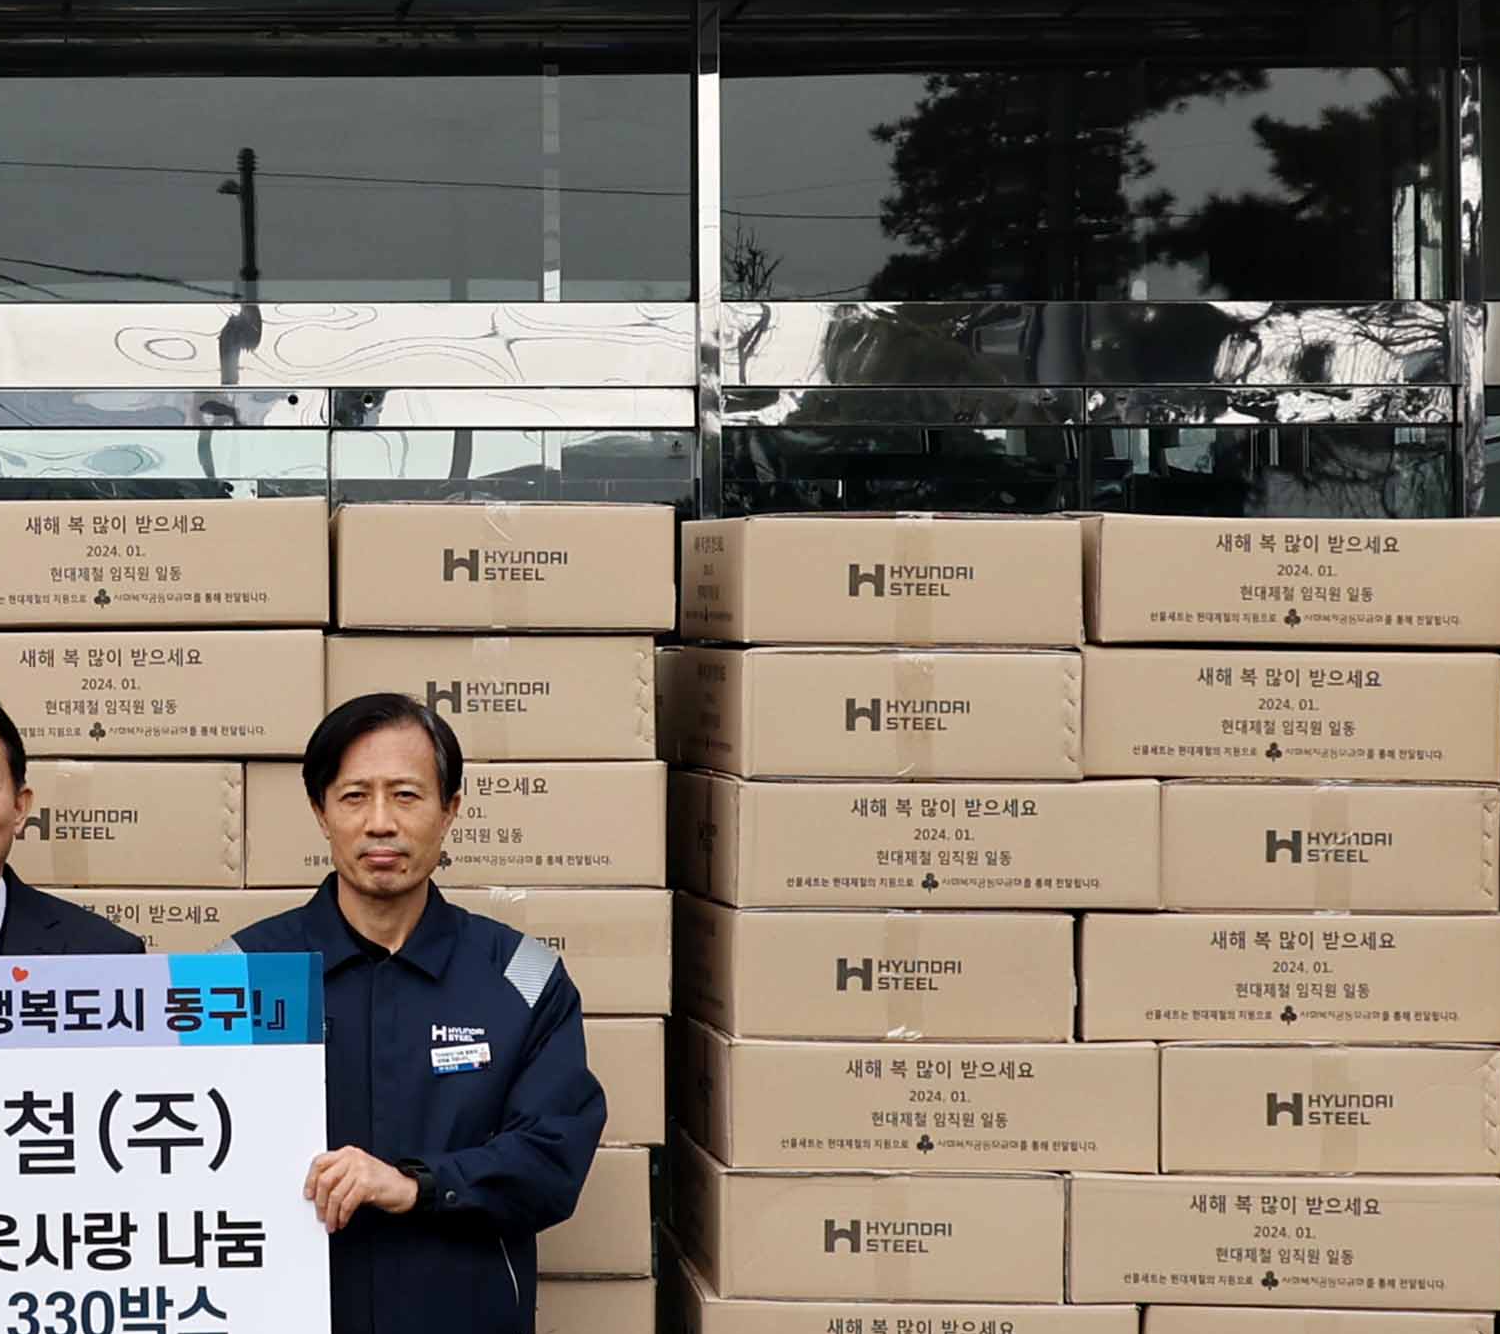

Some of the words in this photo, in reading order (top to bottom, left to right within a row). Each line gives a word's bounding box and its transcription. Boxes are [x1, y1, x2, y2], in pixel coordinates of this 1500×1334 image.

[26, 517, 59, 535] 새해
[68, 517, 84, 534] 복
[93, 516, 126, 534] 많이
[136, 515, 205, 534] 받으세요
[87, 546, 120, 557] 2024.
[126, 545, 144, 556] 01.
[485, 551, 567, 564] HYUNDAI
[51, 567, 103, 582] 현대제철
[110, 567, 149, 581] 임직원
[156, 566, 181, 581] 일동
[485, 568, 544, 580] STEEL
[891, 566, 973, 579] HYUNDAI
[891, 583, 950, 596] STEEL
[159, 1211, 265, 1268] 나눔
